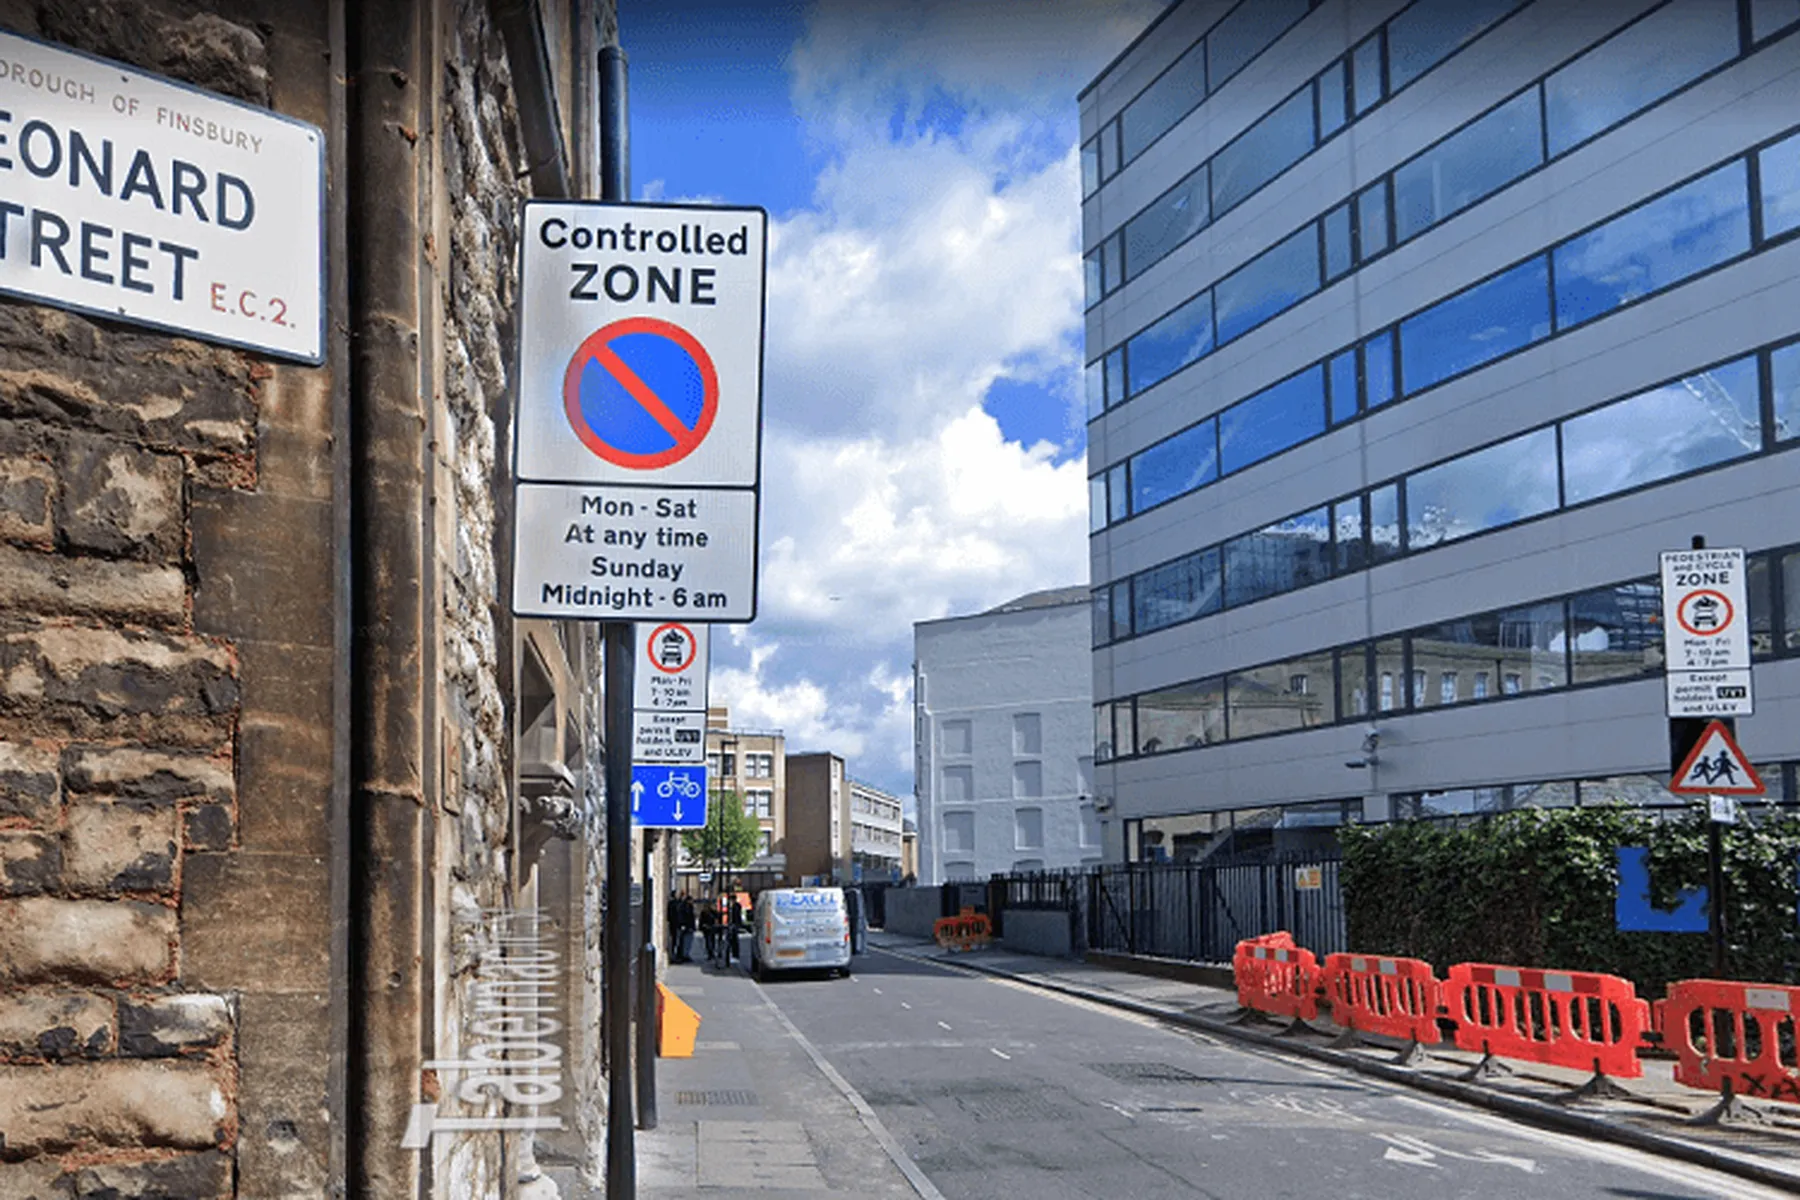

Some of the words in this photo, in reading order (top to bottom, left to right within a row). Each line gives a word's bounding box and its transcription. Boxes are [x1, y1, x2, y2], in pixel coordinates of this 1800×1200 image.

[113, 93, 140, 117] OF
[157, 107, 264, 154] FINSBURY
[540, 218, 748, 255] Controlled
[570, 264, 716, 305] ZONE
[210, 283, 297, 329] E.C.2.
[581, 496, 634, 517] Mon
[655, 498, 697, 518] Sat
[565, 523, 595, 544] At
[604, 529, 646, 550] any
[657, 527, 709, 548] time
[590, 556, 684, 582] Sunday
[1665, 552, 1740, 562] PEDESTRIAN
[1673, 563, 1693, 572] and
[1696, 561, 1734, 569] CYCLE
[1676, 572, 1729, 586] ZONE
[541, 583, 653, 610] Midnight
[672, 588, 688, 608] 6
[693, 591, 728, 608] am
[1690, 674, 1727, 682] Except
[1706, 703, 1737, 712] ULEV
